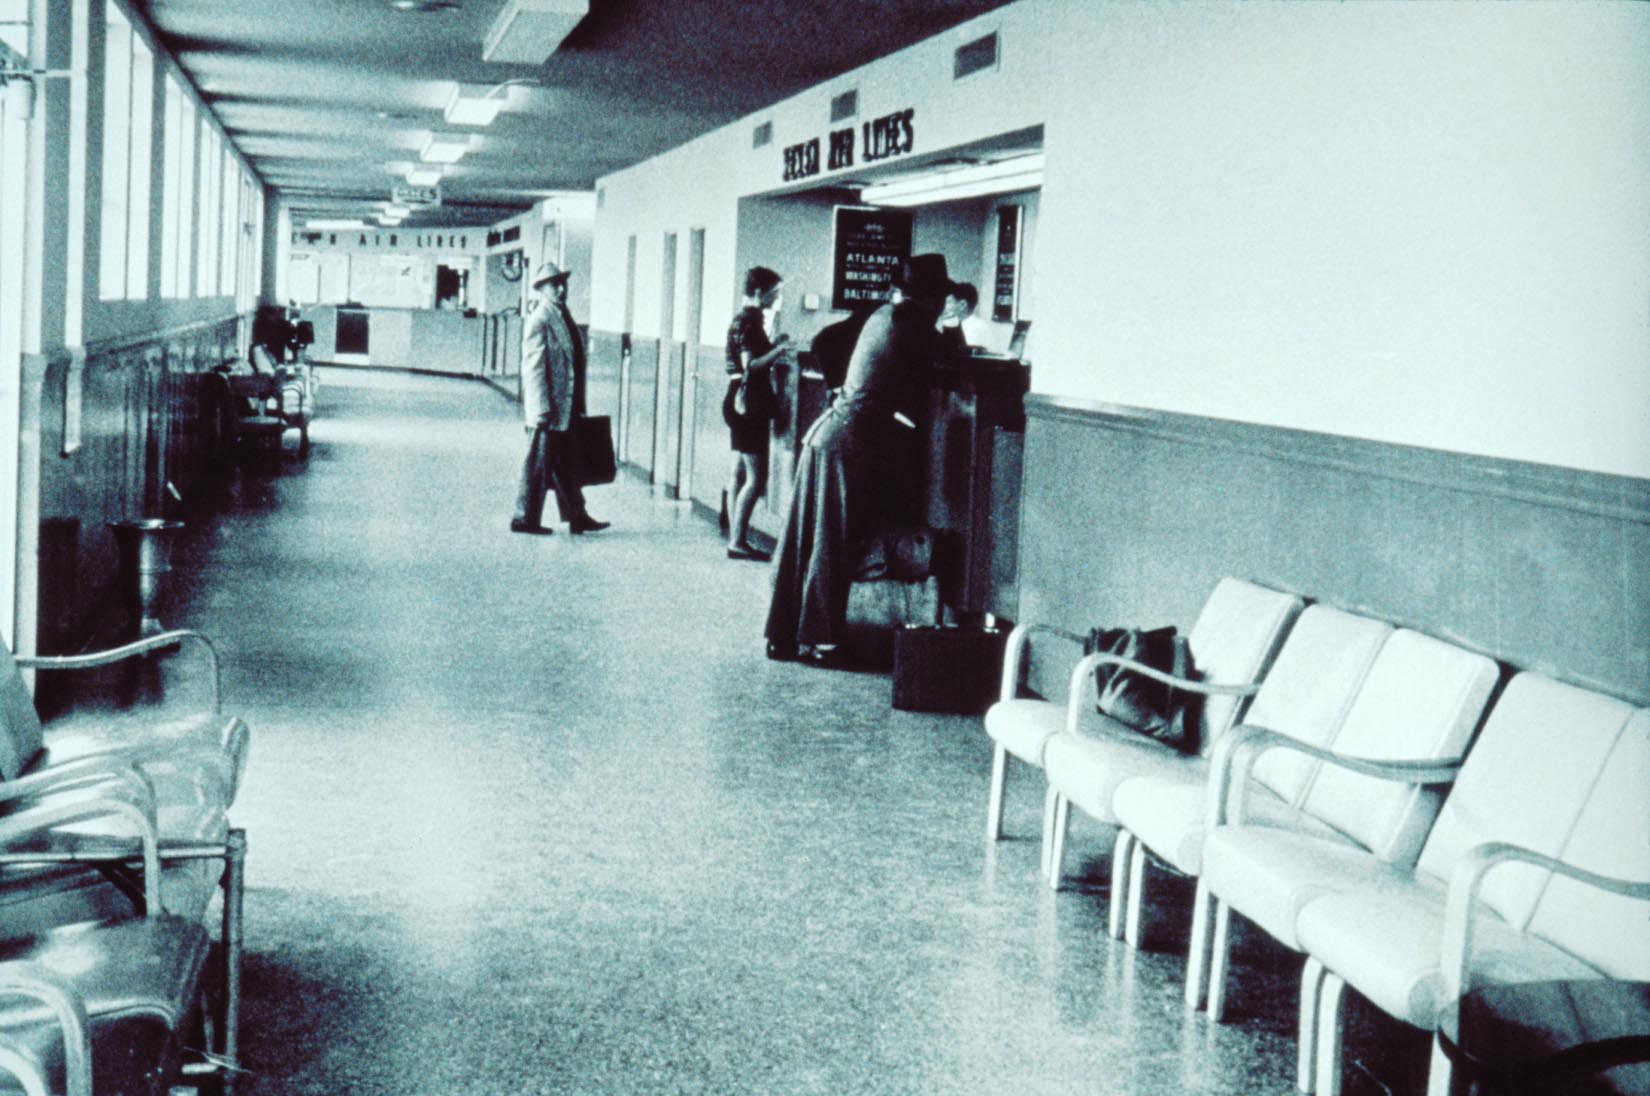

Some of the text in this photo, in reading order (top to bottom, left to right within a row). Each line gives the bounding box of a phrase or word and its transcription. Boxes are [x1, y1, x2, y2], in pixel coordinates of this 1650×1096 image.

[862, 108, 915, 162] LINES
[359, 233, 467, 249] AIR LINES
[846, 252, 899, 266] ATLANTA
